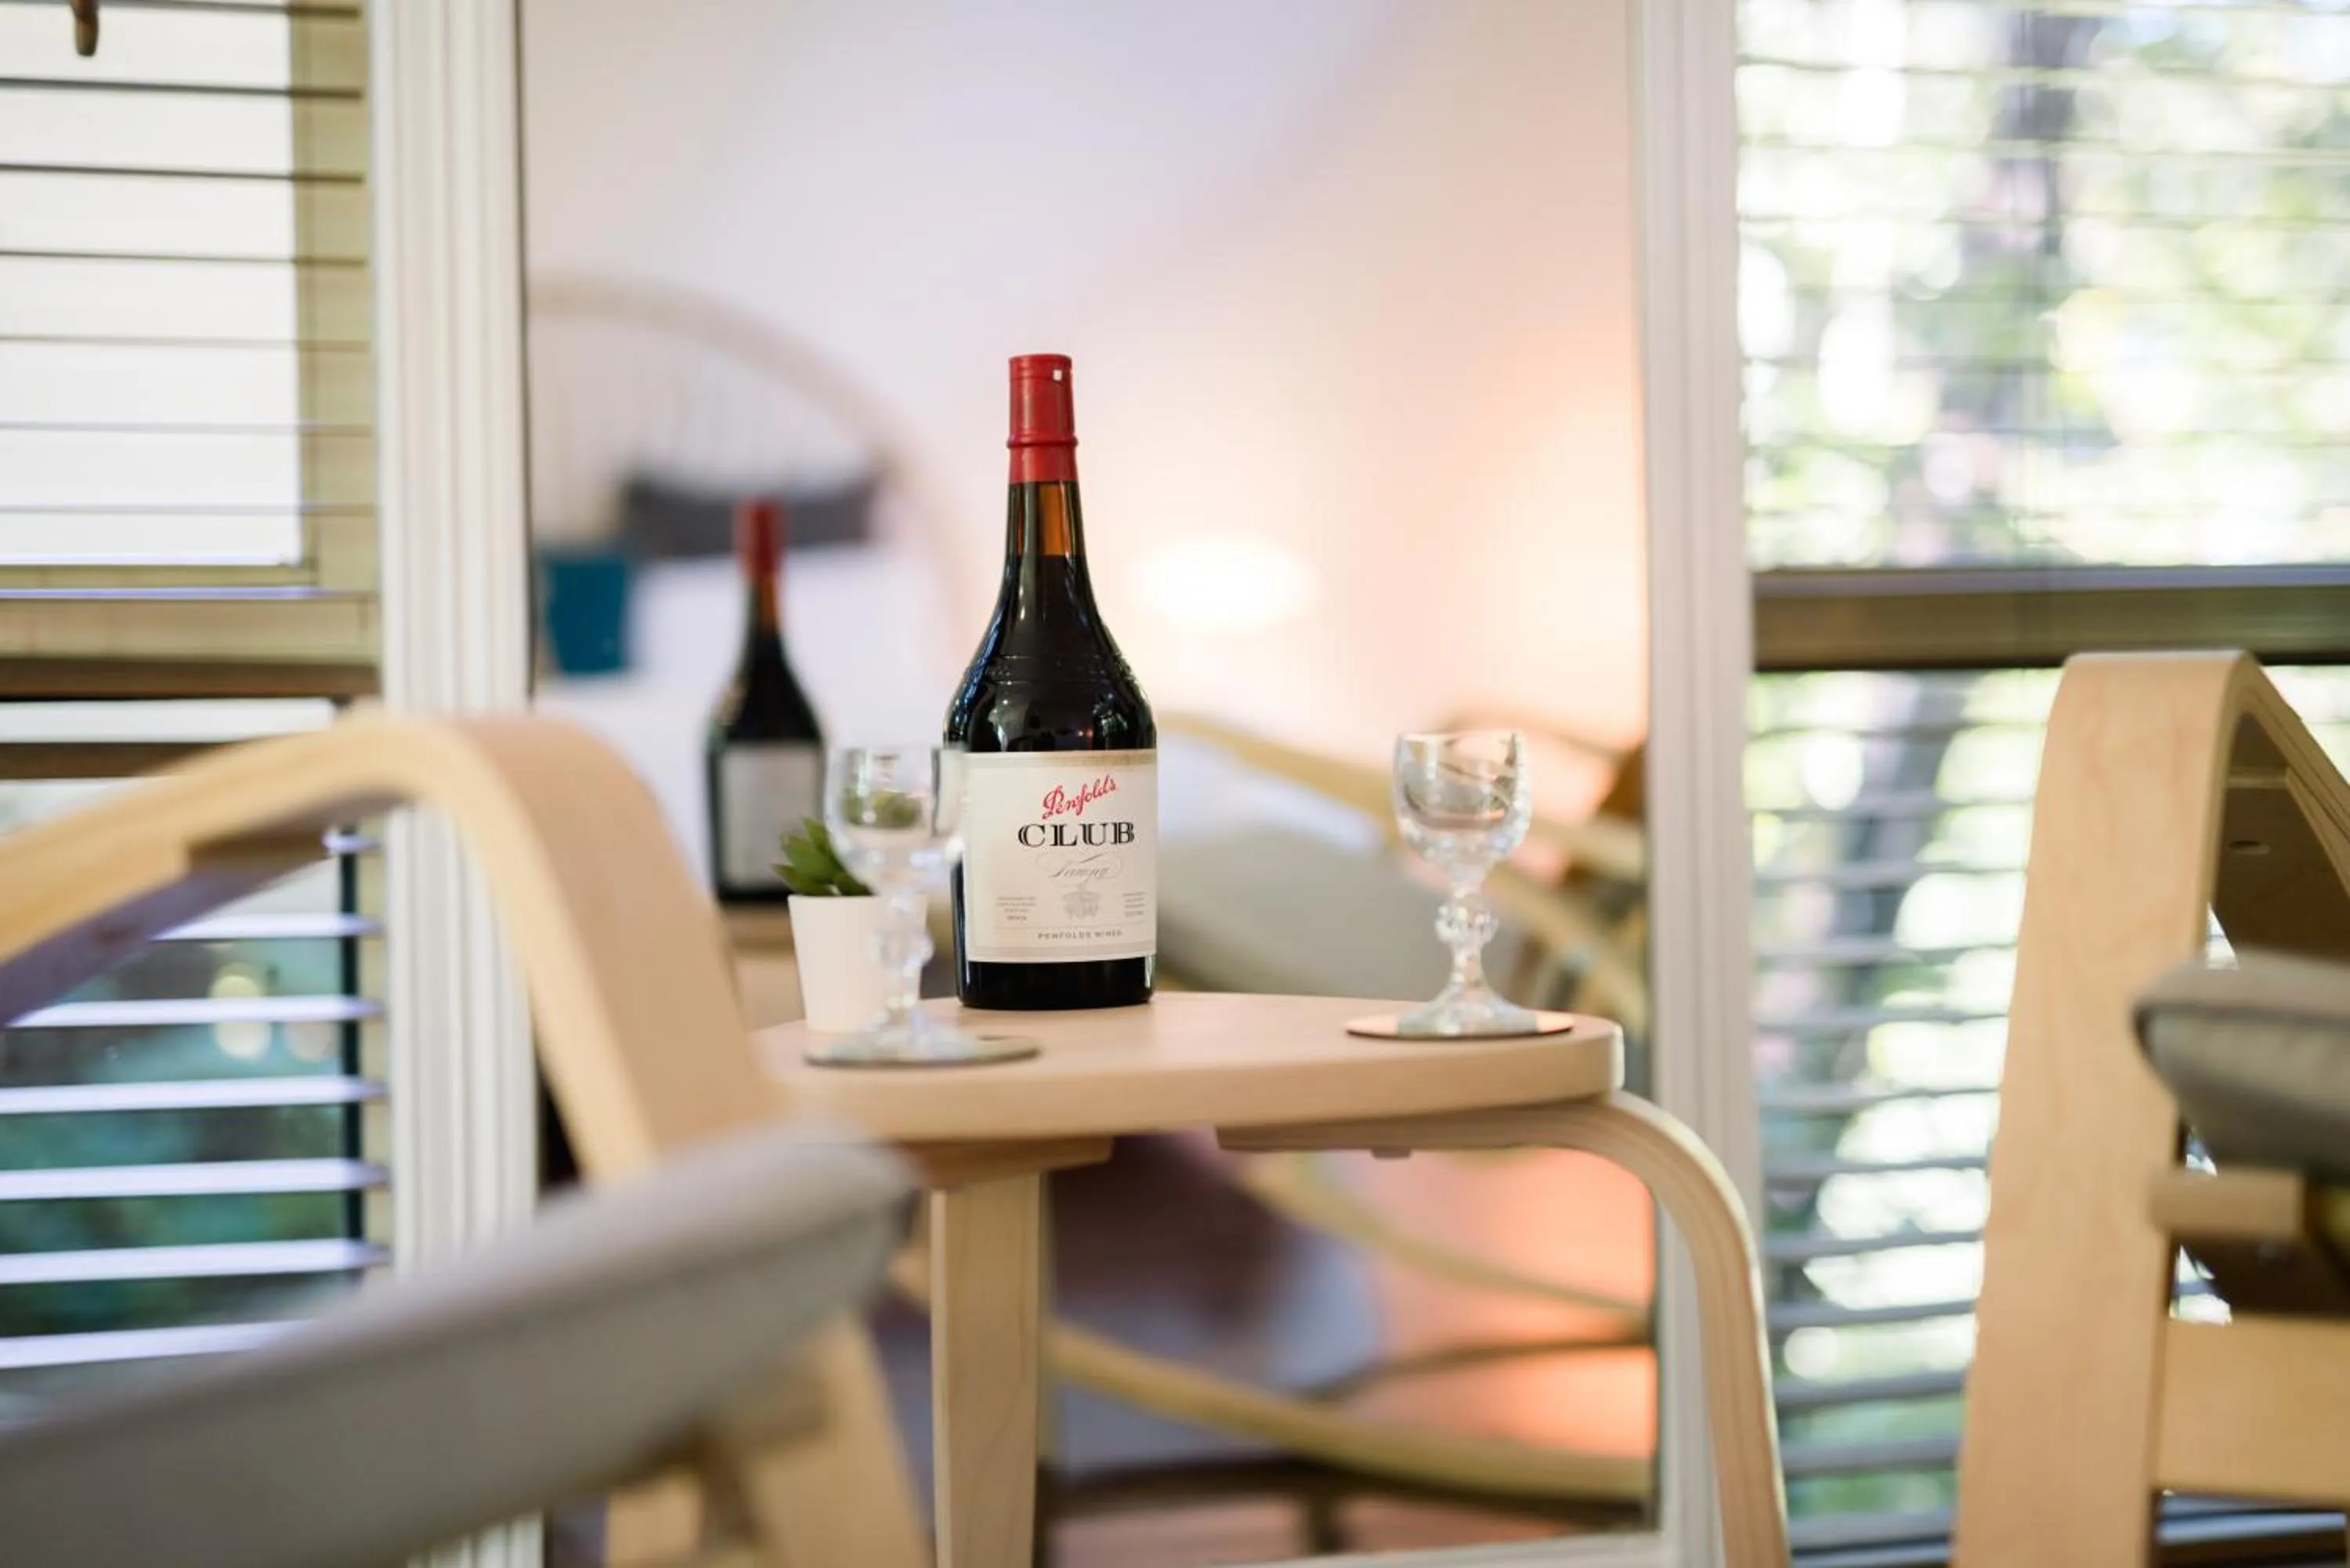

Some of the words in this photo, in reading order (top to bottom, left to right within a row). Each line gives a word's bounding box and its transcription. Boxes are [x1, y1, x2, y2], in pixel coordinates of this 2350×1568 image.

[1042, 775, 1117, 819] Penfolds
[1018, 822, 1135, 848] CLUB
[1037, 930, 1092, 940] PENFOLDS
